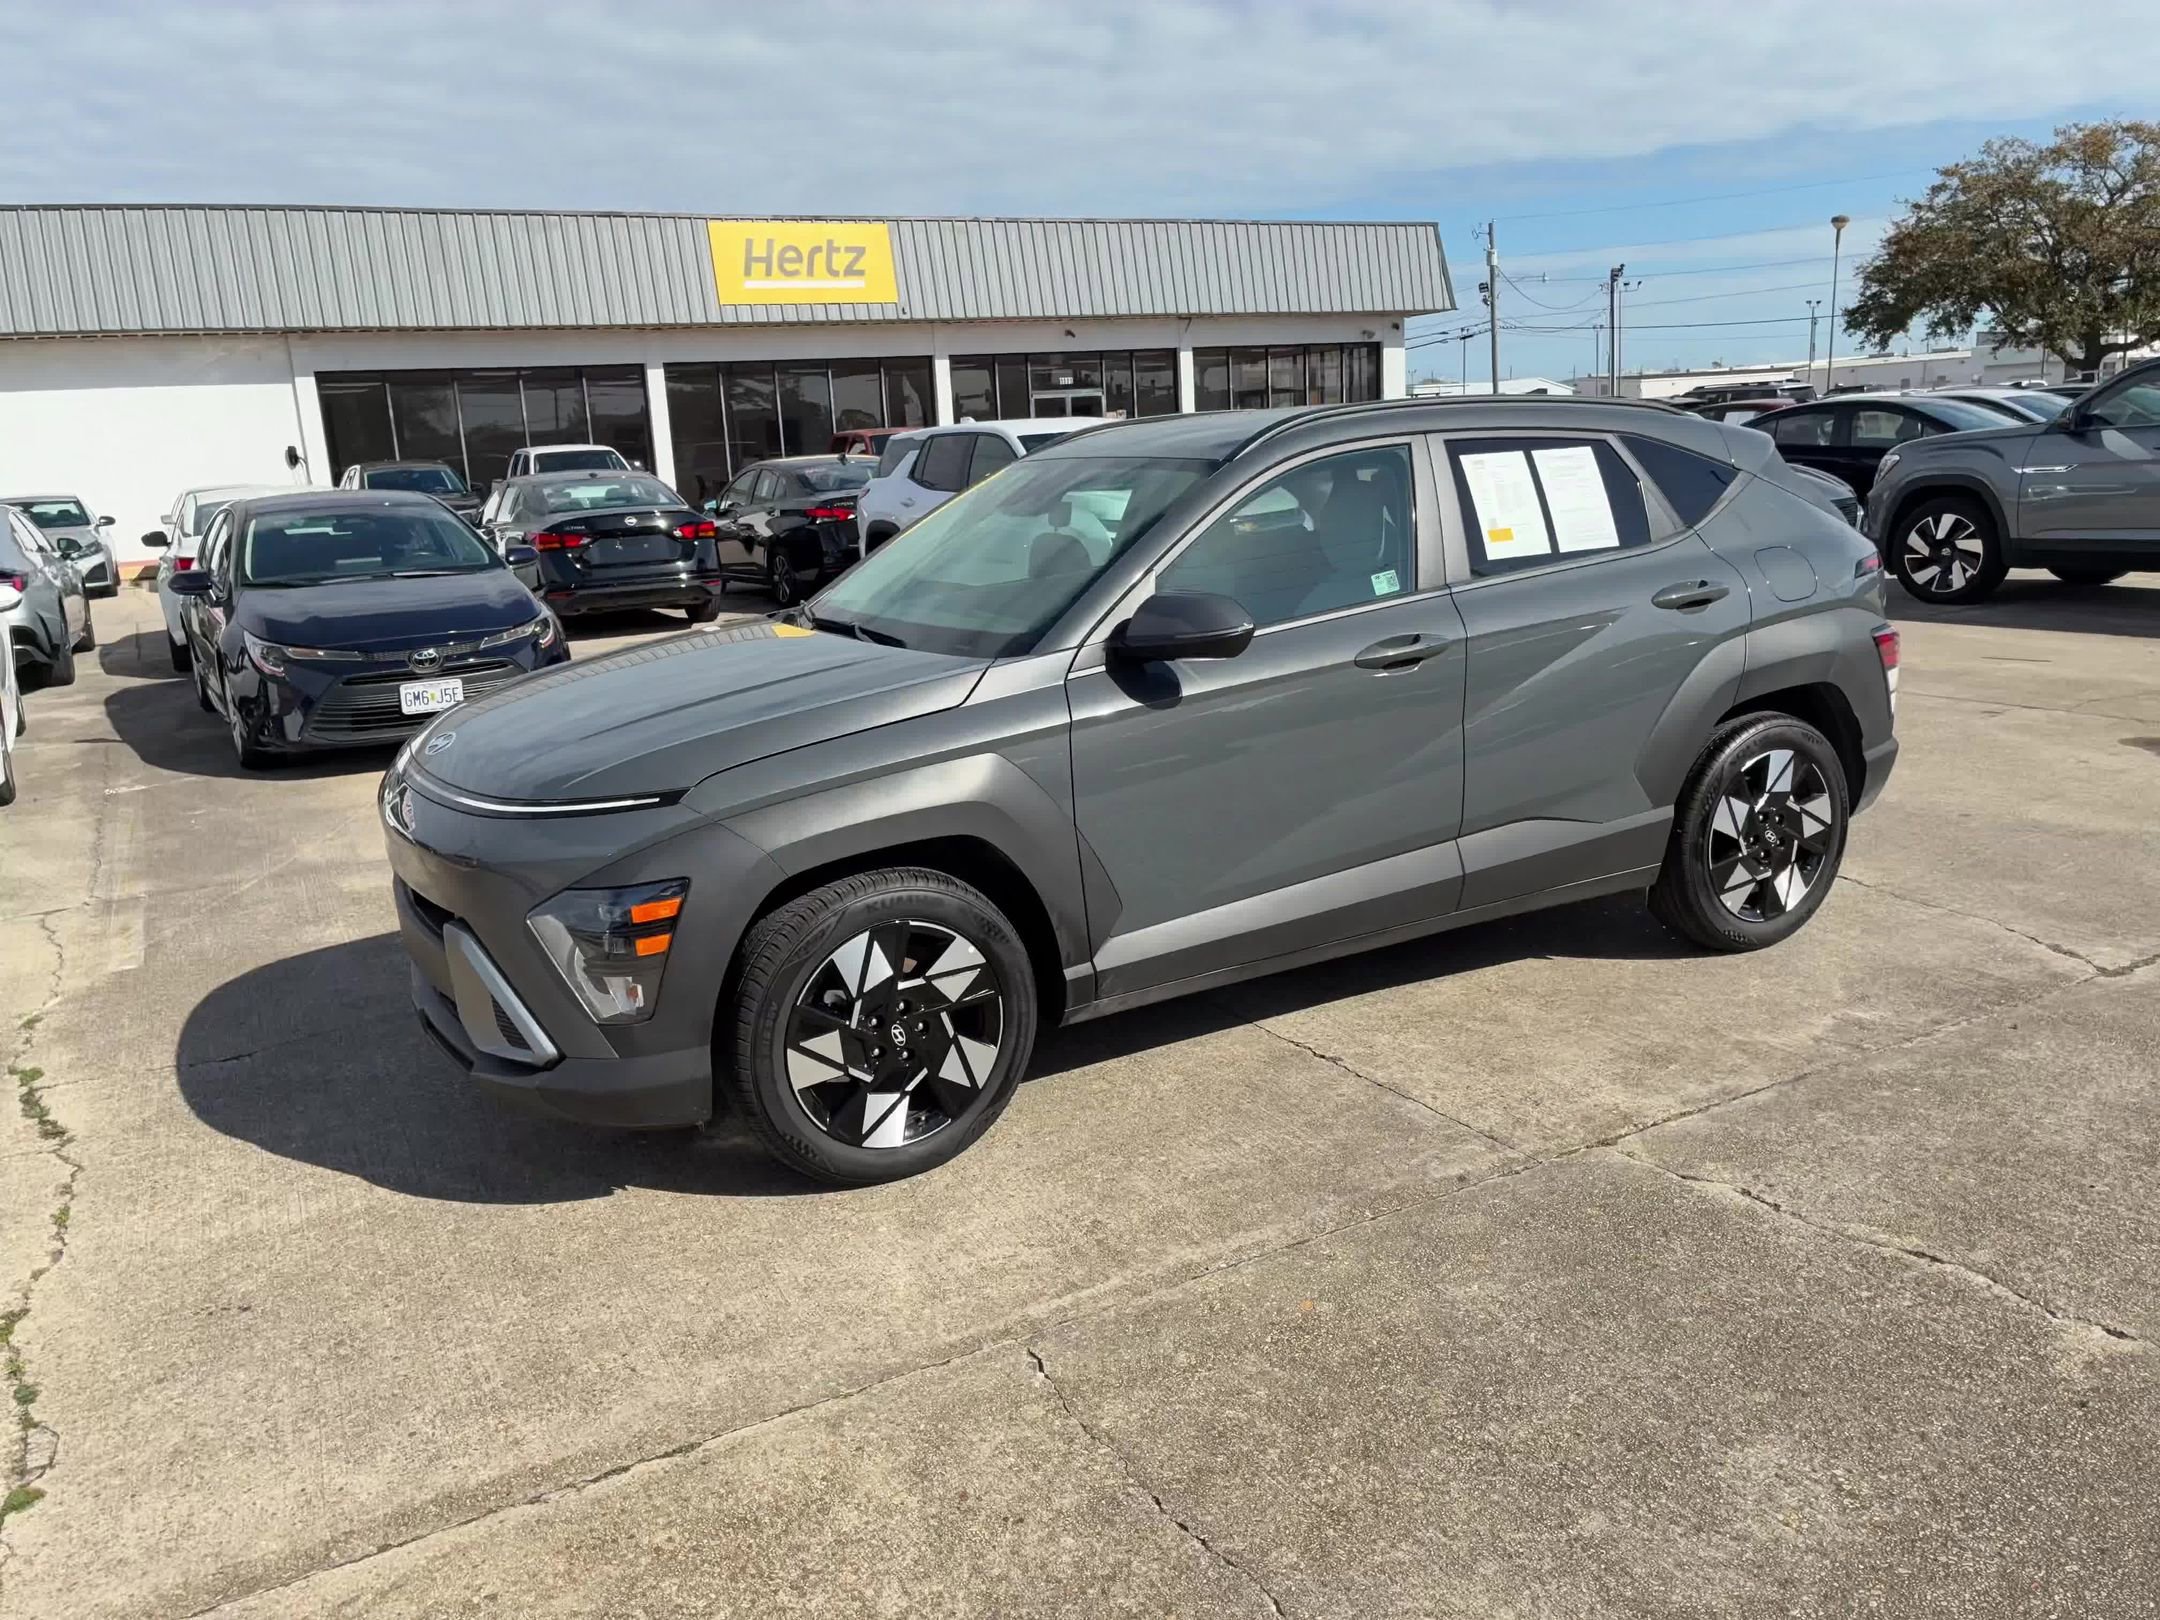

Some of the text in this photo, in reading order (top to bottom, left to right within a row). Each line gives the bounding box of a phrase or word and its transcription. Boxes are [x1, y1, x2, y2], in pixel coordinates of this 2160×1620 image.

[744, 238, 867, 278] Hertz
[404, 690, 430, 707] GM6
[865, 894, 945, 913] KUMH
